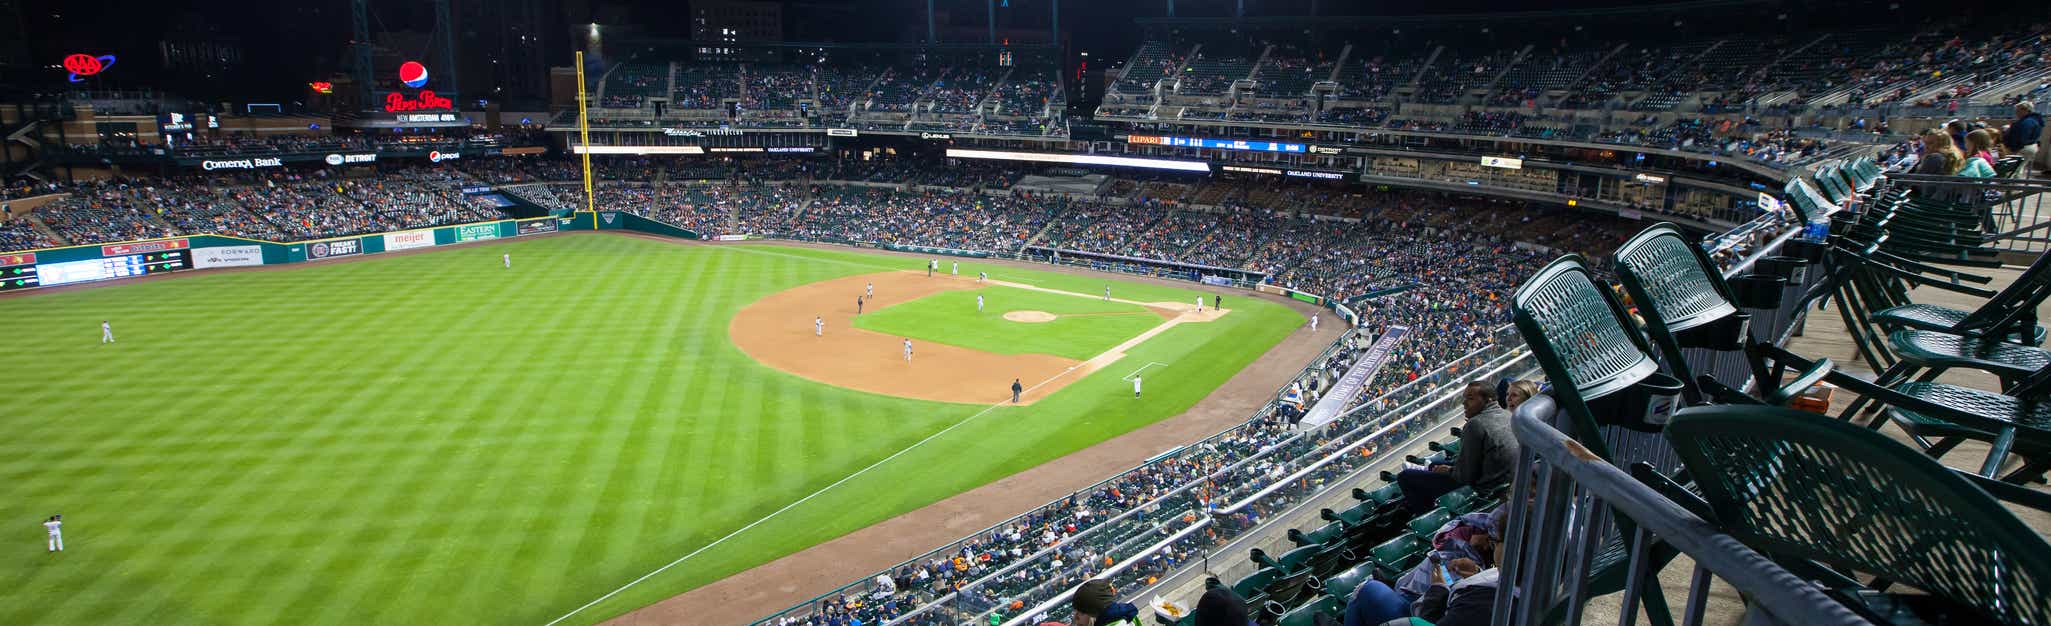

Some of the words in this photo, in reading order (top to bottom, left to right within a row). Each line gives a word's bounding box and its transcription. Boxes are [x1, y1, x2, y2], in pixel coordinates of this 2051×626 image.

[345, 154, 377, 163] DETROIT
[441, 152, 460, 161] pepsi
[254, 157, 282, 167] Bank
[1287, 170, 1312, 178] OAKLAND
[1312, 172, 1344, 180] UNIVERSITY
[460, 224, 495, 235] EASTERN
[394, 232, 425, 244] meijer
[330, 246, 356, 256] FAST!
